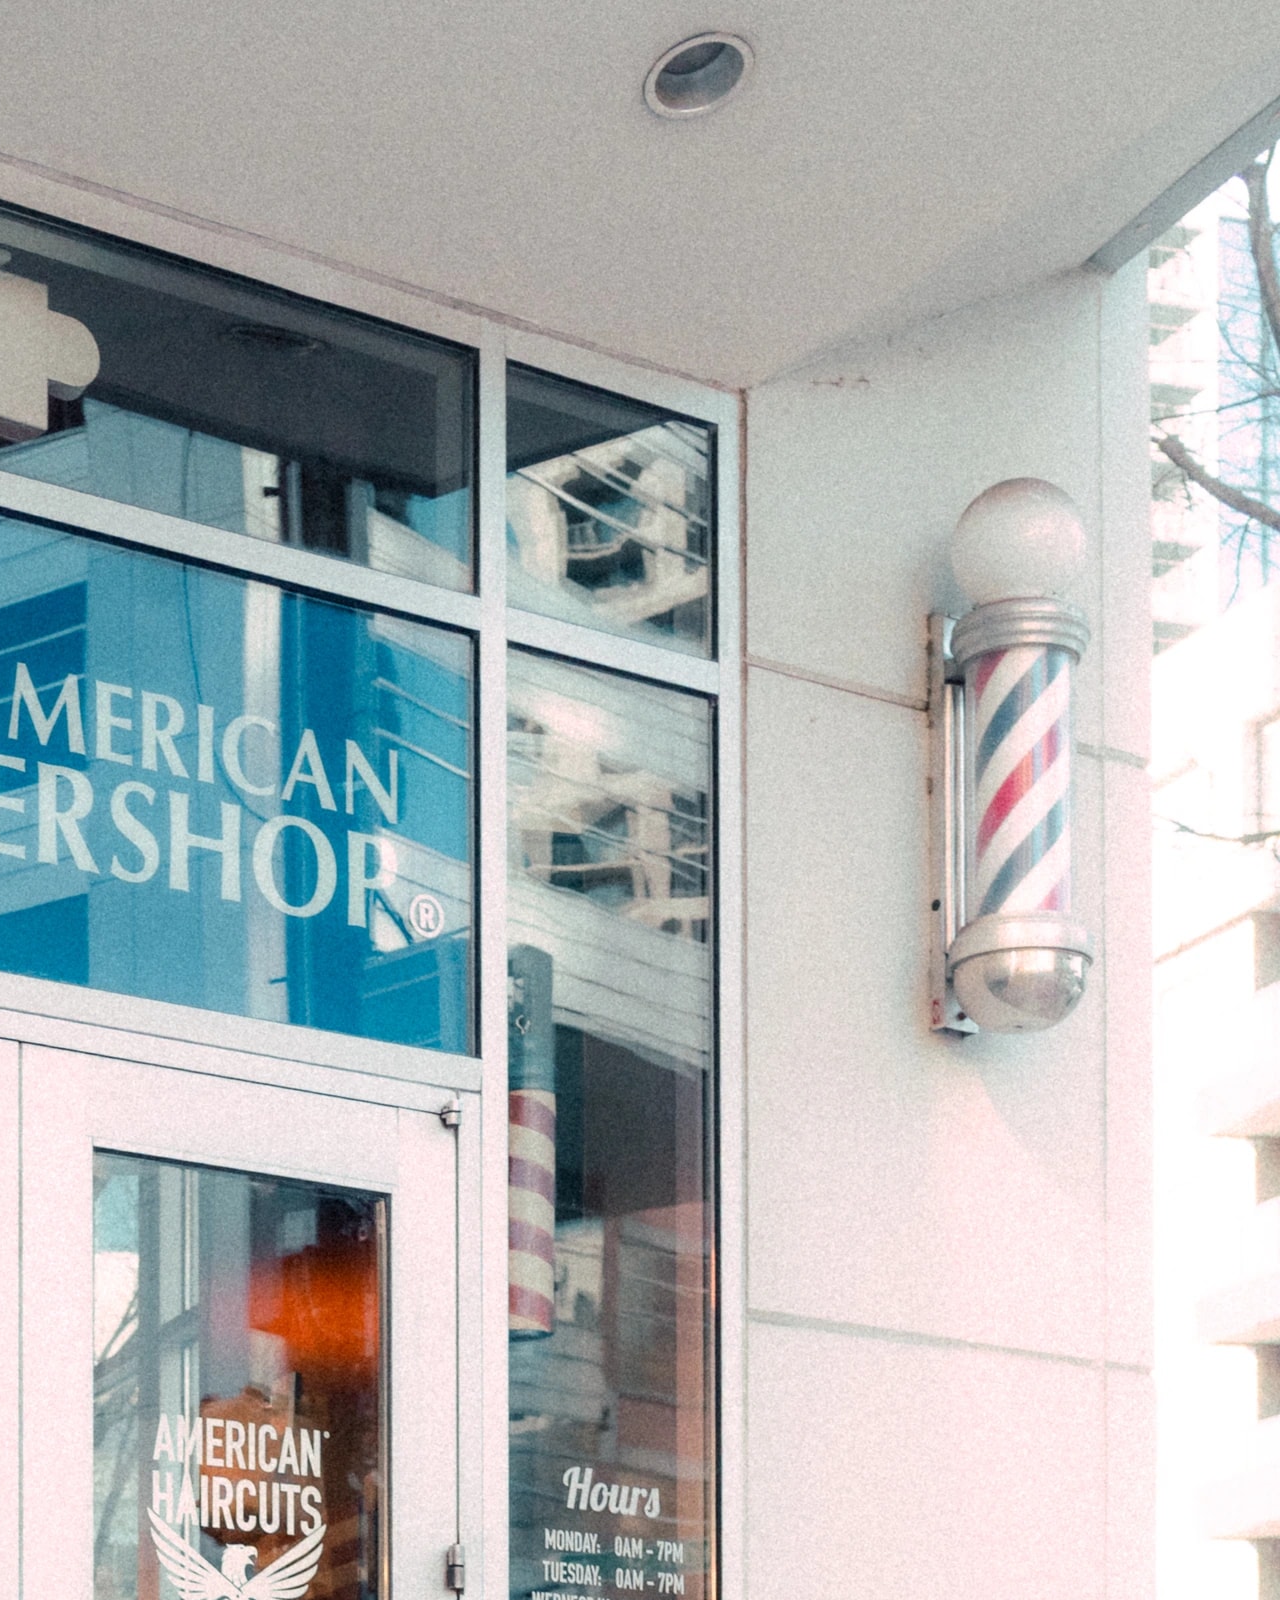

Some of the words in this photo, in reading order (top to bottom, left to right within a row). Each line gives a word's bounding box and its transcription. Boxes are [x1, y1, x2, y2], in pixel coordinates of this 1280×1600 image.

[152, 1413, 322, 1478] AMERICAN
[152, 1470, 324, 1537] HAIRCUTS
[562, 1466, 661, 1519] Hours
[656, 1540, 684, 1564] 7PM
[657, 1572, 685, 1595] 7PM
